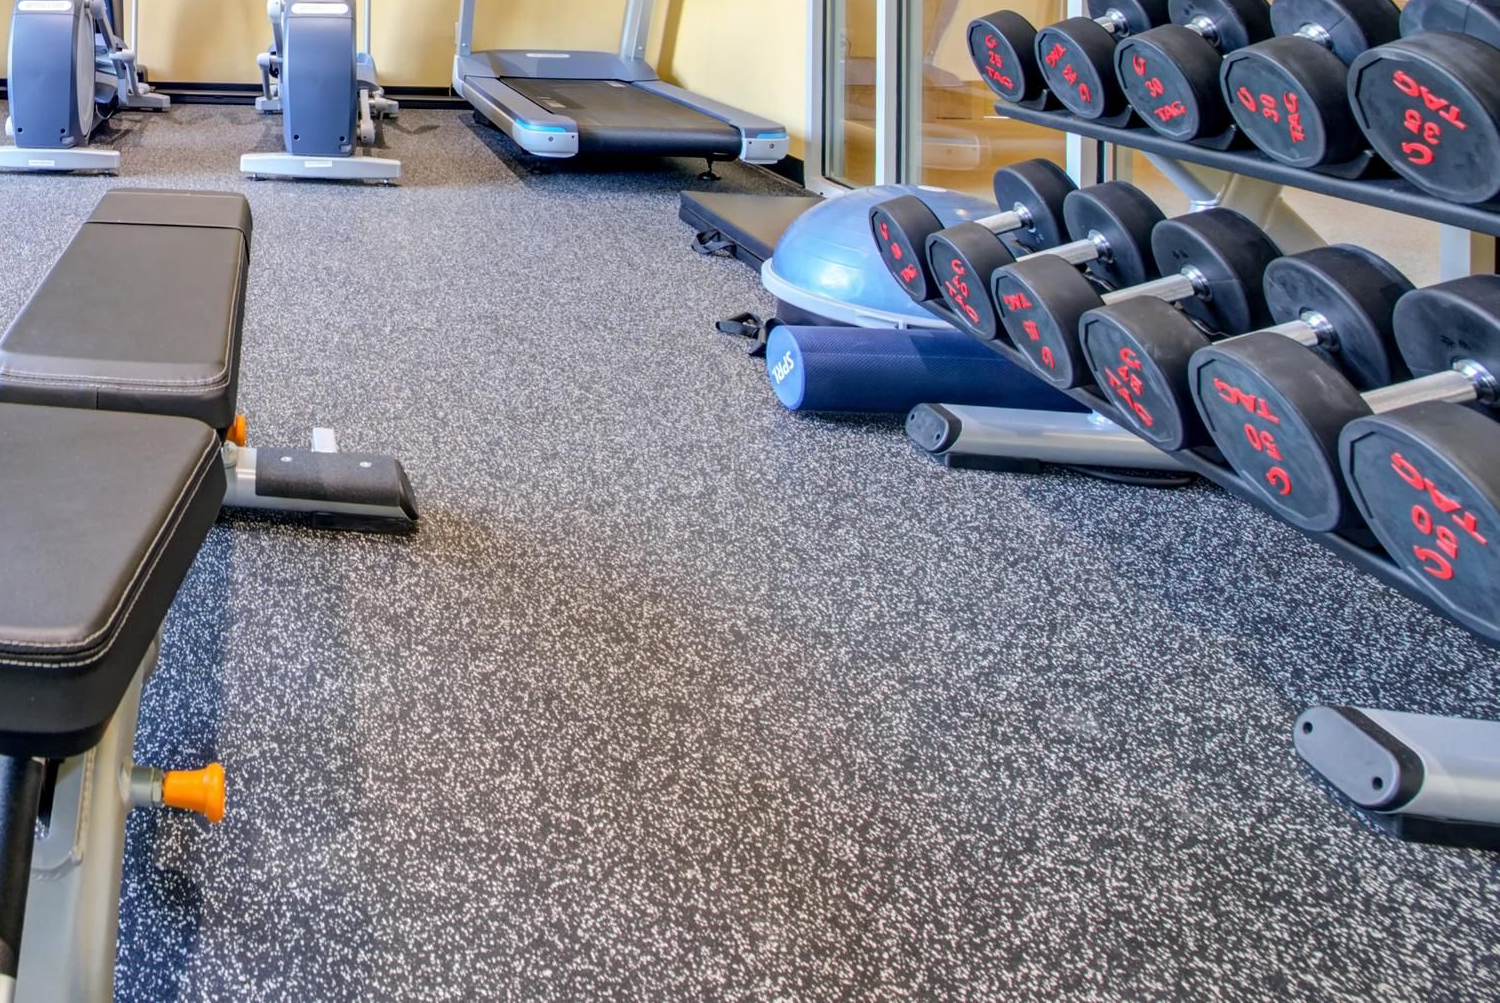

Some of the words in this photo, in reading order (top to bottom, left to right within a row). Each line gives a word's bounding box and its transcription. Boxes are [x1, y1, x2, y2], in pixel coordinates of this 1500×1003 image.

[1145, 77, 1165, 98] 30
[1260, 94, 1280, 123] 30
[1392, 70, 1467, 131] TAG
[1155, 101, 1187, 122] TAG
[1283, 92, 1306, 143] TAG
[1403, 108, 1442, 146] 35
[1104, 367, 1154, 428] TAG
[1213, 378, 1280, 424] TAG
[1243, 423, 1283, 462] 50
[1390, 452, 1489, 546] TAG
[1411, 504, 1459, 560] 50
